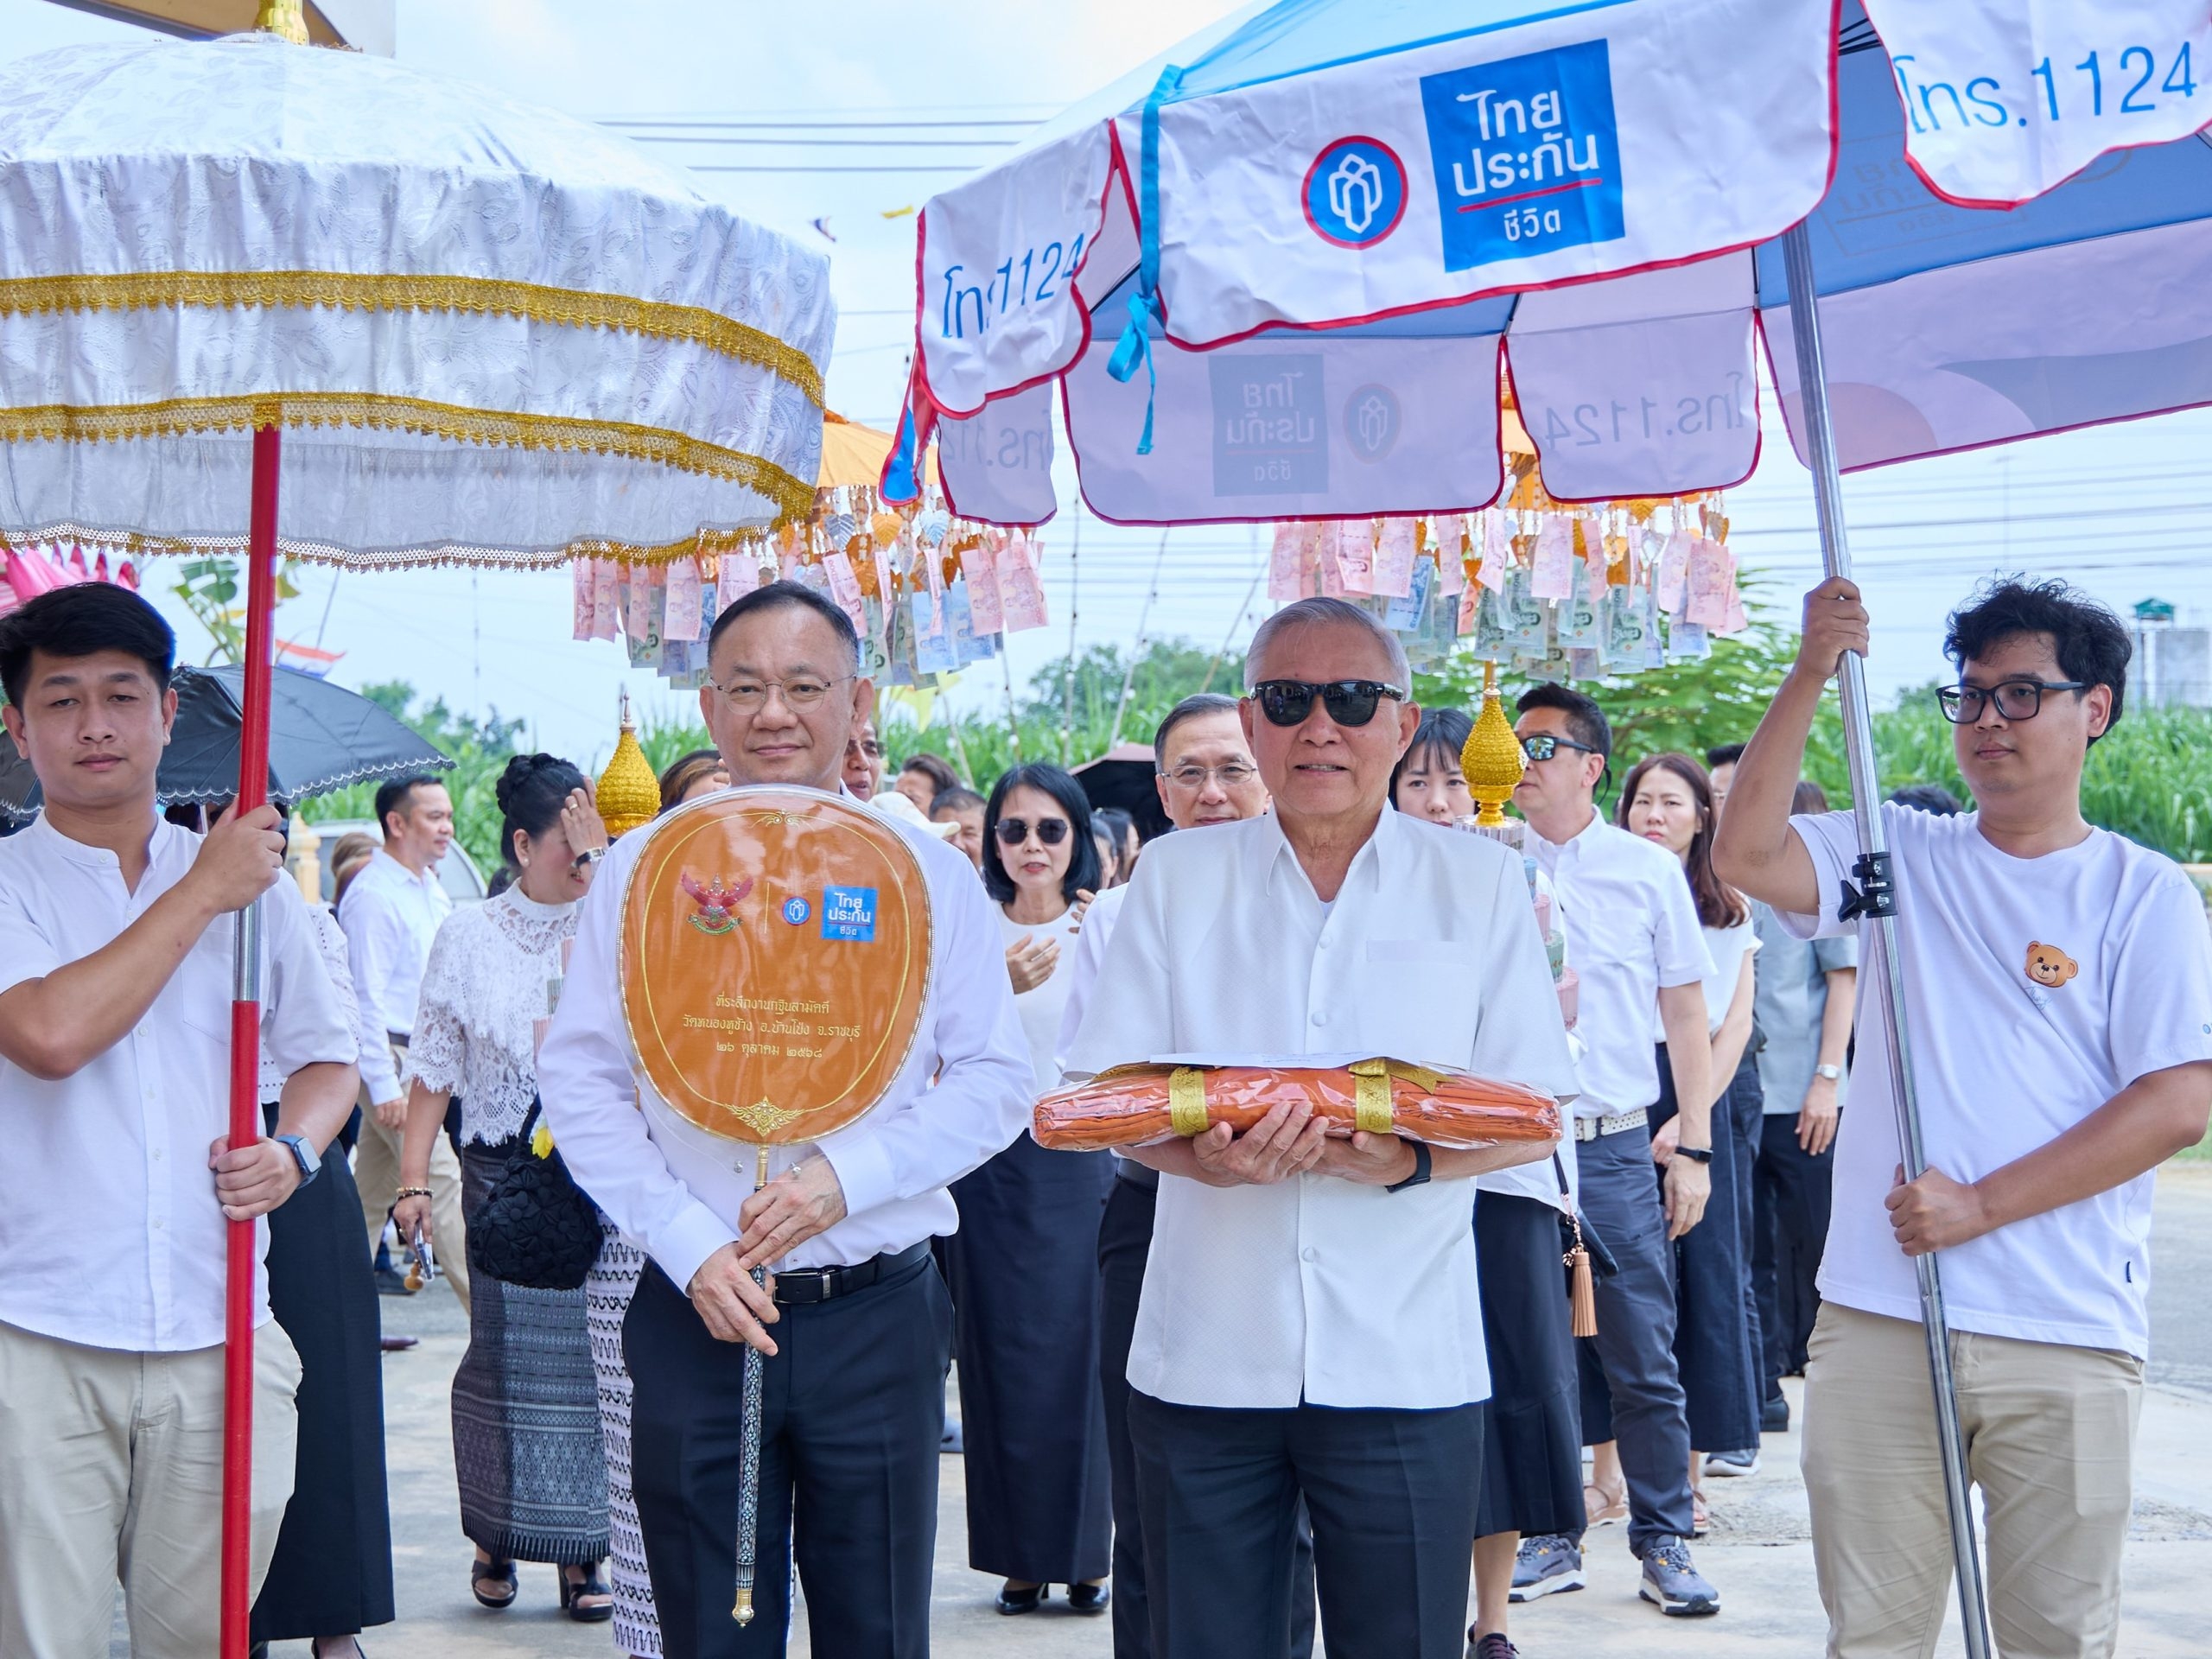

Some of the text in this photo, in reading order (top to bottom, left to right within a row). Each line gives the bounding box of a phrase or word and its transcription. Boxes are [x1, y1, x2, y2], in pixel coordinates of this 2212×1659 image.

[1892, 41, 2197, 134] โทร.1124
[1456, 89, 1562, 141] ไทย
[1452, 131, 1600, 197] ประกัน
[1503, 207, 1562, 242] ชีวิต
[828, 907, 871, 923] ประกัน
[833, 892, 862, 909] ไทย
